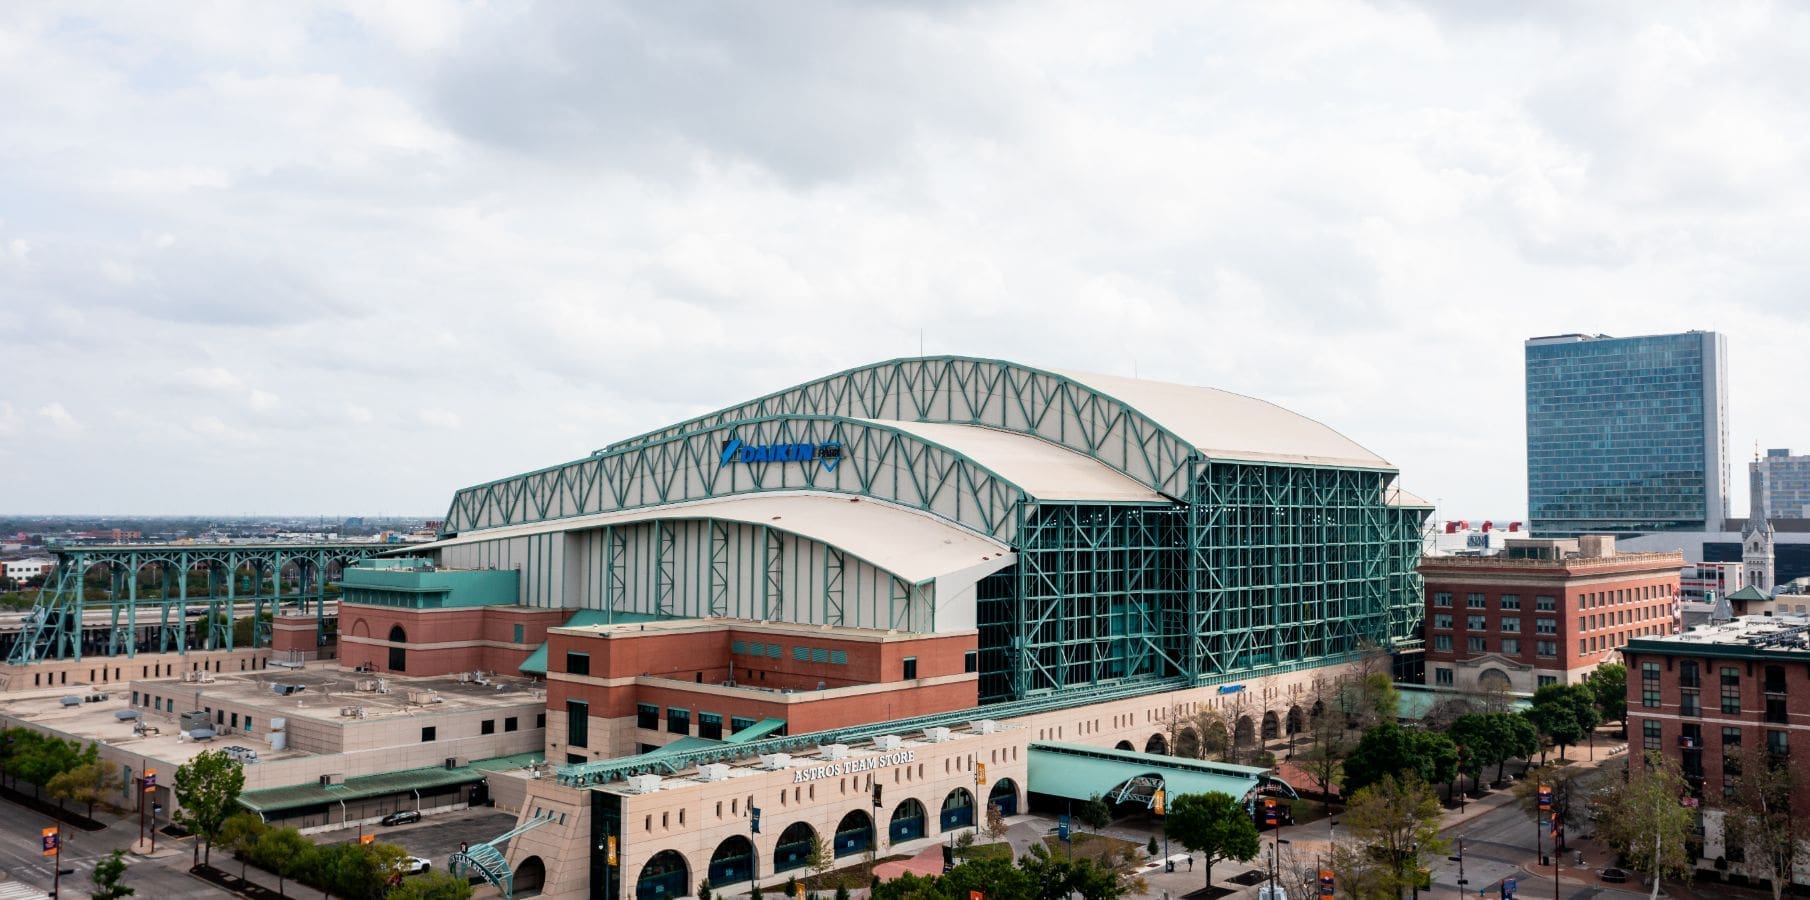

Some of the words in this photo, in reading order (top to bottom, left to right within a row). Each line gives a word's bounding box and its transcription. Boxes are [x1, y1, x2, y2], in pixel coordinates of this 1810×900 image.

[741, 443, 814, 464] DAIKIN
[794, 763, 840, 783] ASTROS
[843, 757, 877, 774] TEAM
[880, 750, 915, 768] STORE
